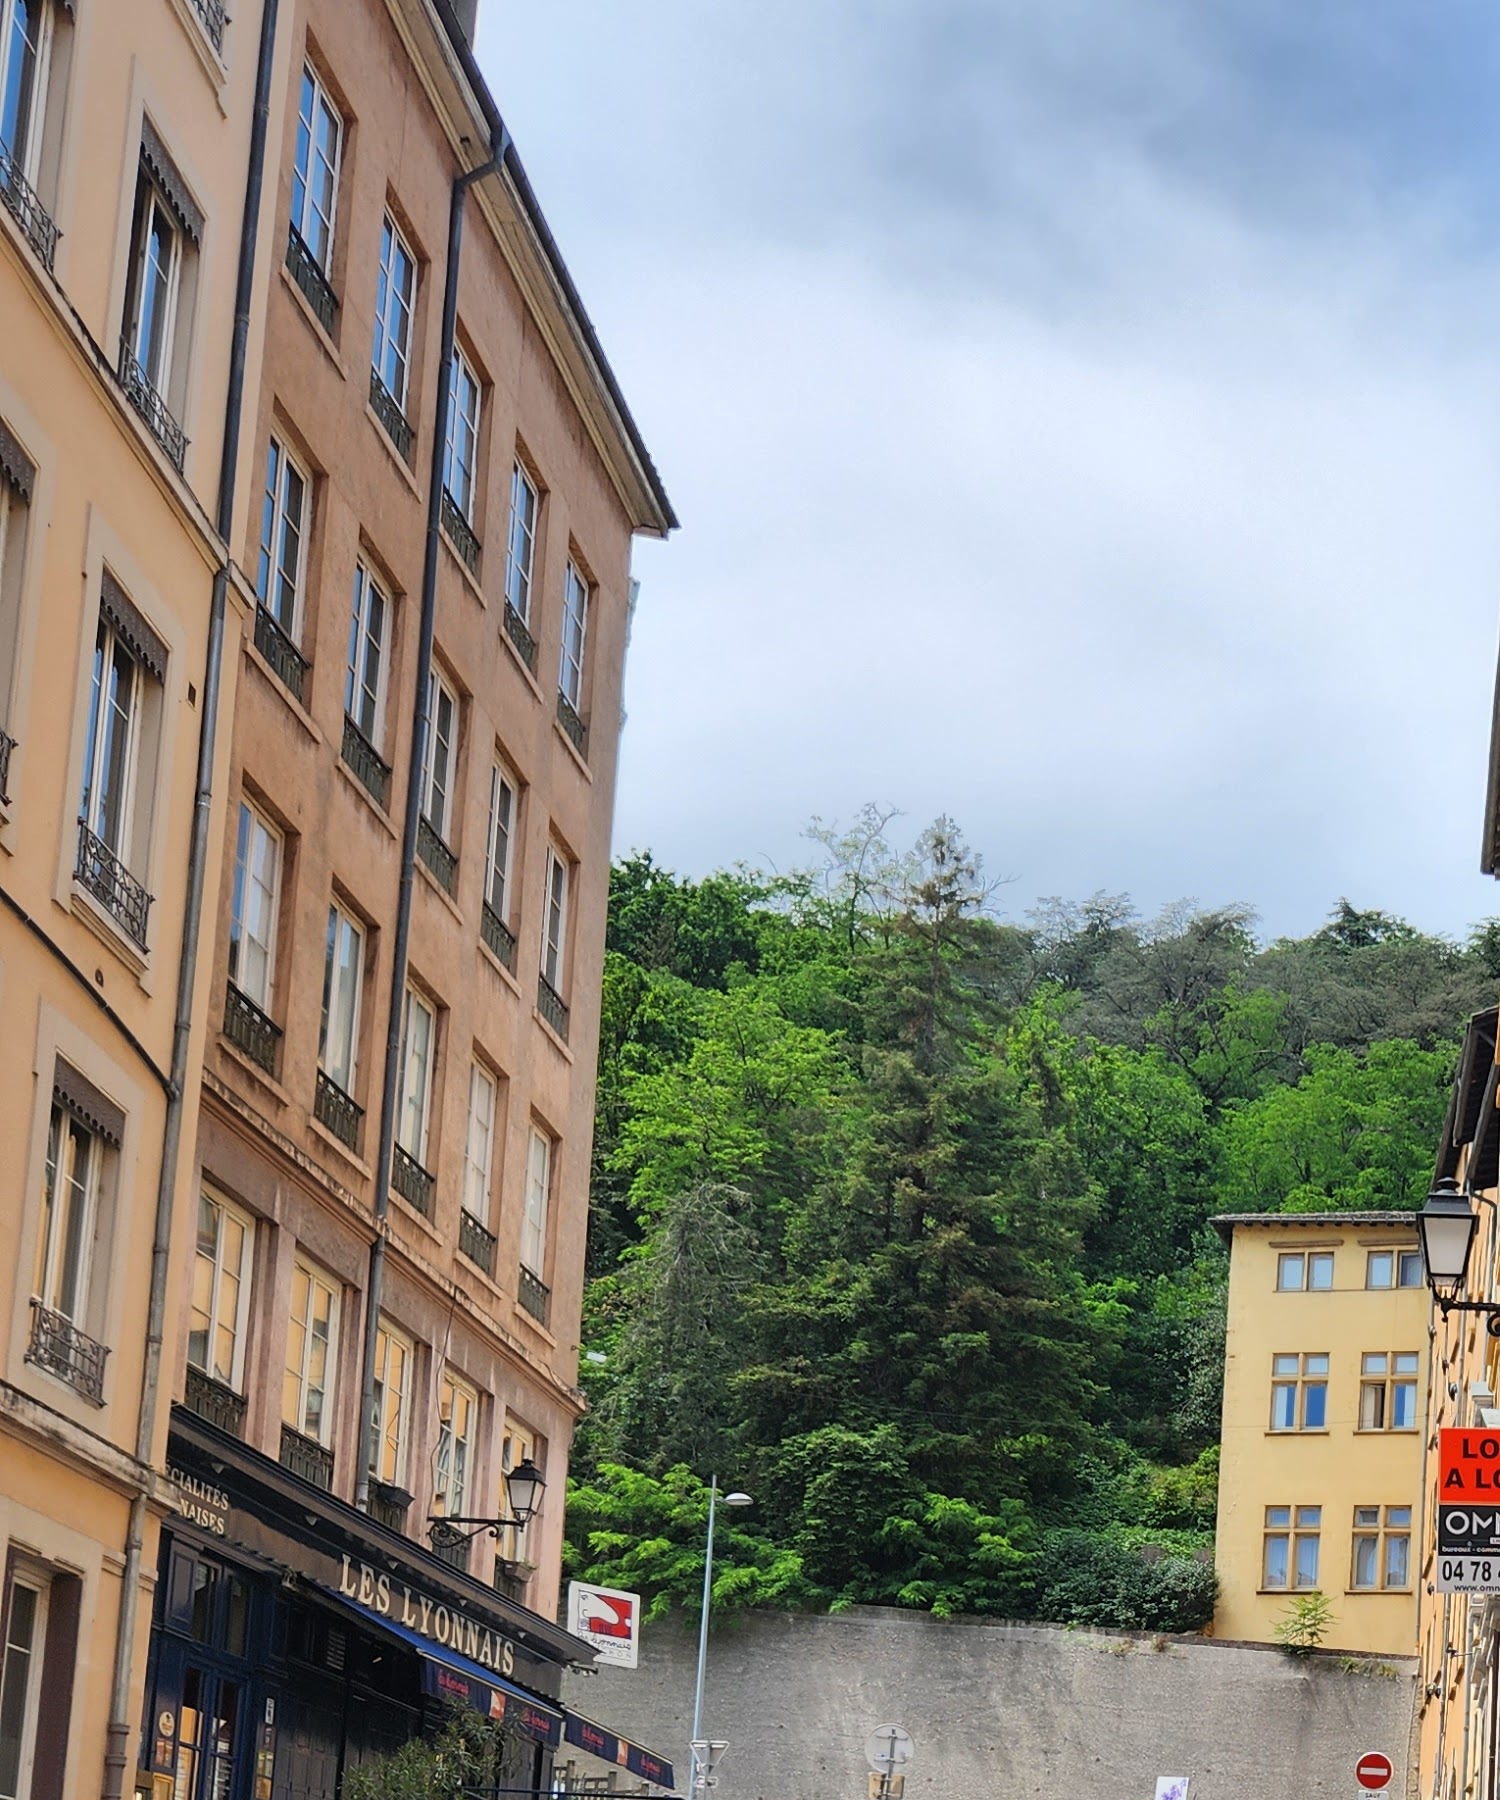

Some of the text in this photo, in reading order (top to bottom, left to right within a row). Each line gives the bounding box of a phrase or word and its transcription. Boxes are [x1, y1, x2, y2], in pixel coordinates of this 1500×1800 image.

[1444, 1468, 1465, 1489] A
[179, 1498, 225, 1535] NAISES
[1442, 1560, 1464, 1581] 04
[1470, 1560, 1491, 1582] 78
[338, 1553, 514, 1676] LES LYONNAIS
